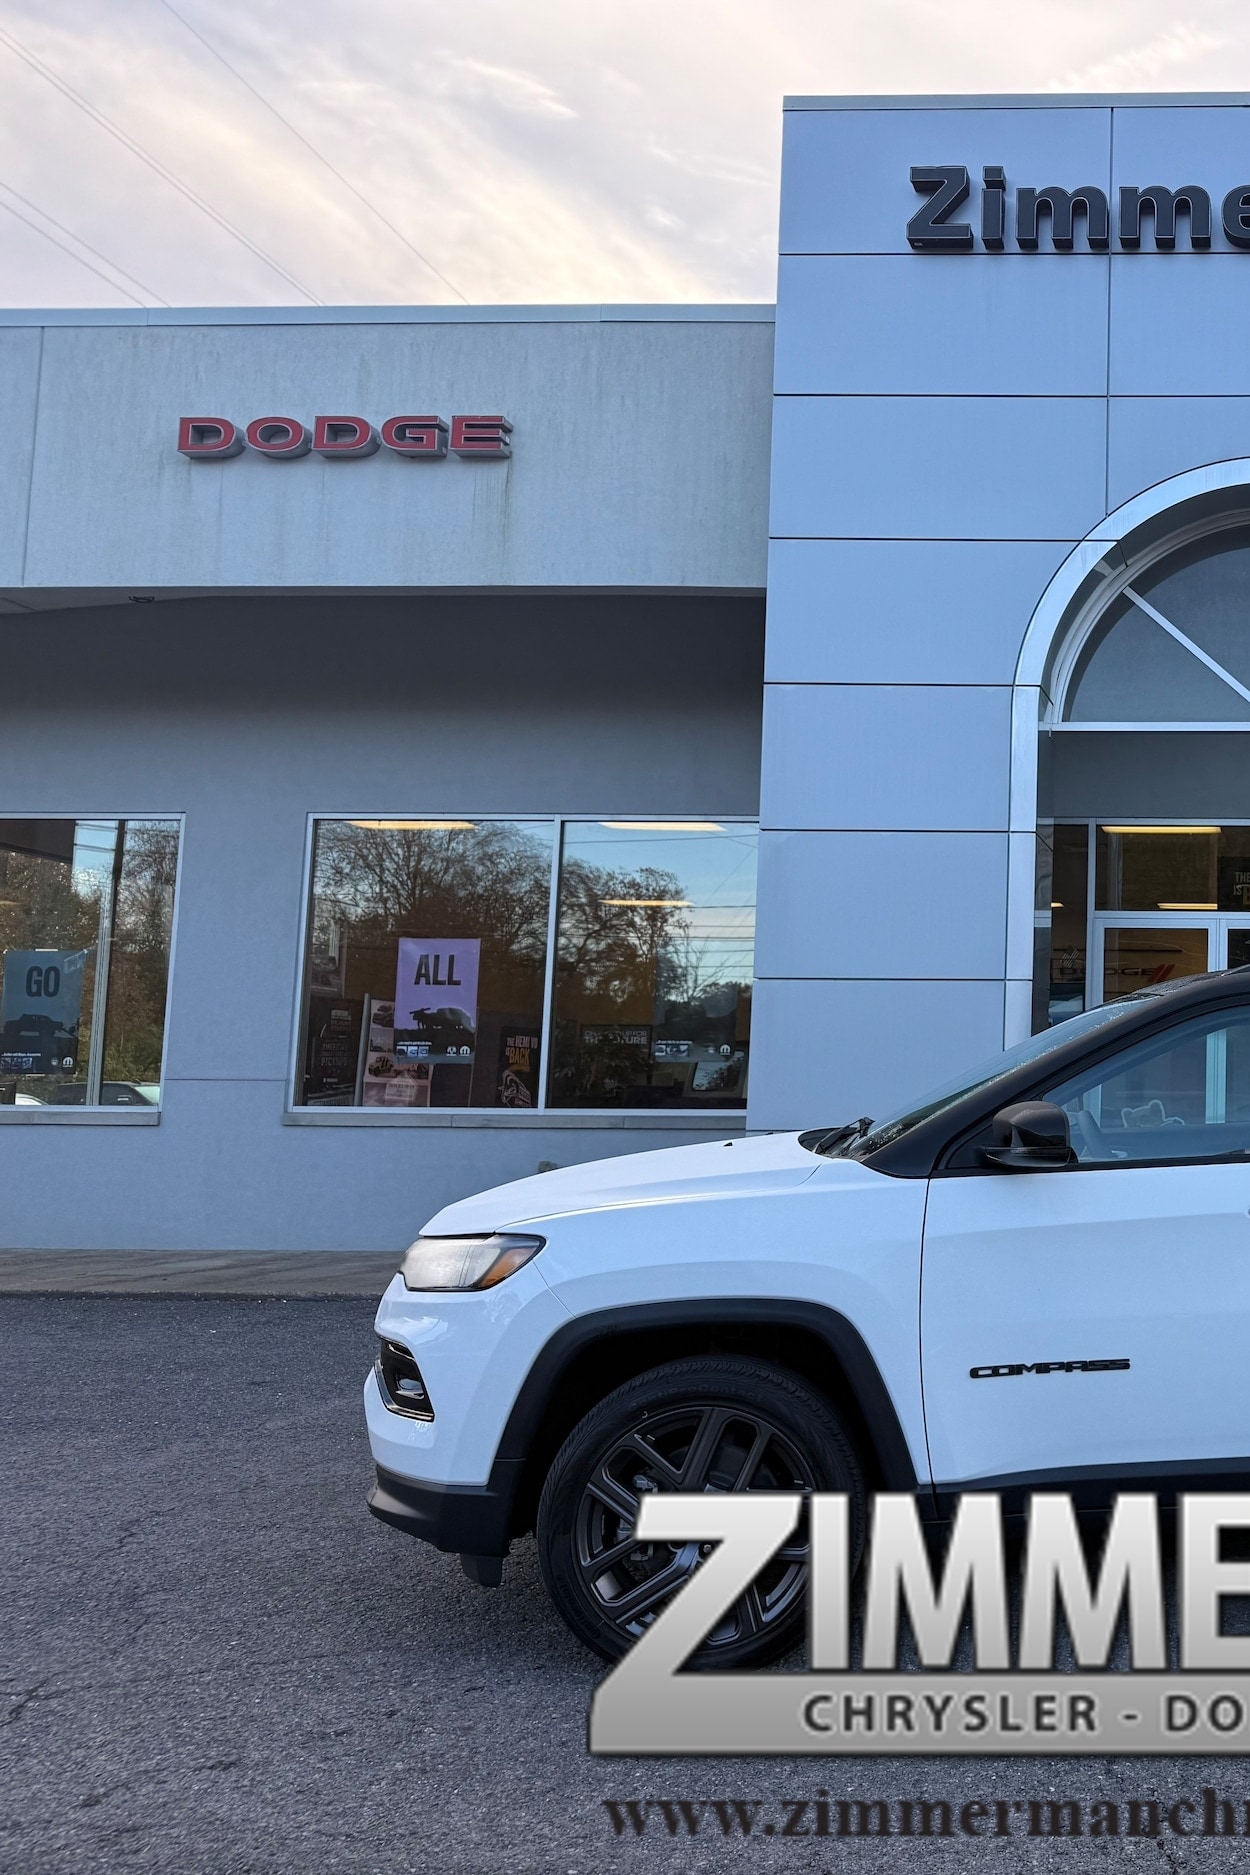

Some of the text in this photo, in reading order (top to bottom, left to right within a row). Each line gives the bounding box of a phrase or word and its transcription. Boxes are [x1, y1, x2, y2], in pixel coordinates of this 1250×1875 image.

[178, 415, 513, 459] DODGE
[26, 966, 60, 997] GO
[413, 954, 462, 986] ALL
[509, 1047, 530, 1064] BACK
[970, 1358, 1131, 1379] COMPASS
